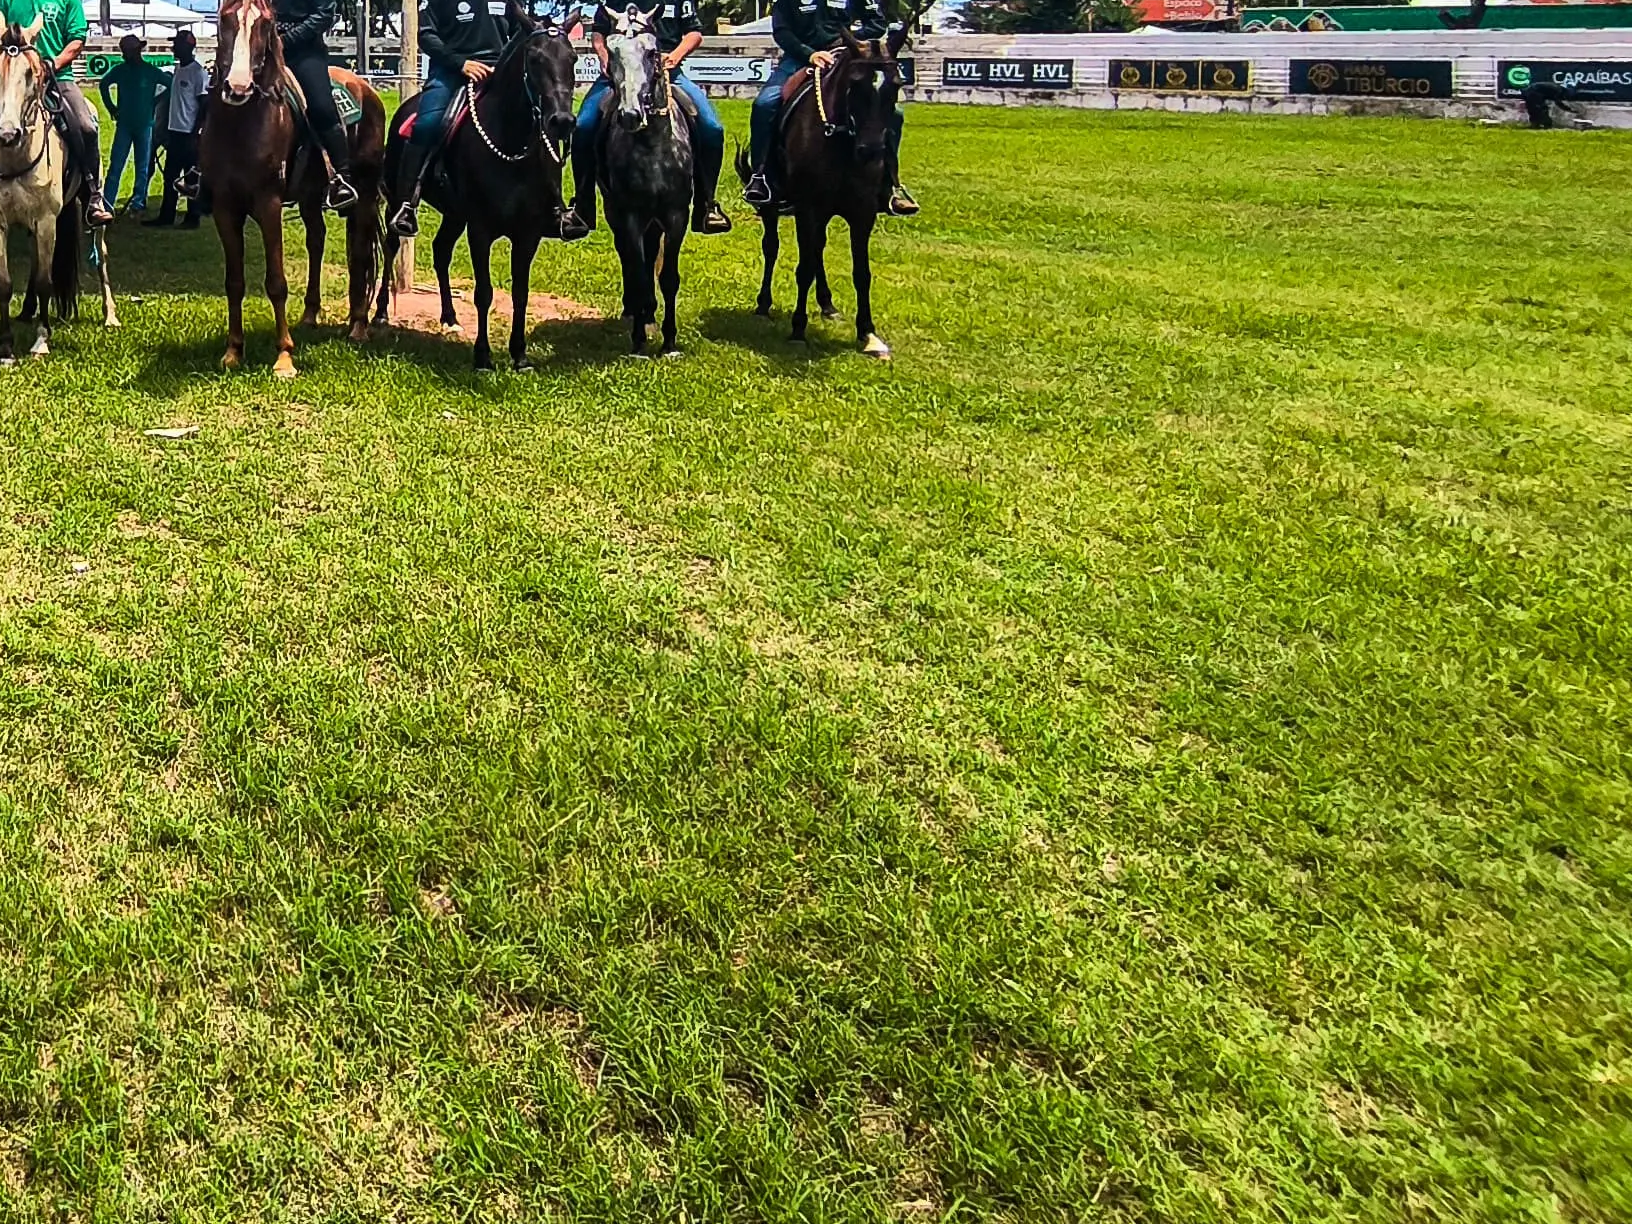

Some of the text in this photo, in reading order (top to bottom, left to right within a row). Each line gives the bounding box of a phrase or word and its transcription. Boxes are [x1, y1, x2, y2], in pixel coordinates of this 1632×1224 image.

[948, 63, 1068, 78] HVL HVL HVL
[1344, 65, 1386, 76] HARAS
[1552, 69, 1632, 85] CARAÍBAS
